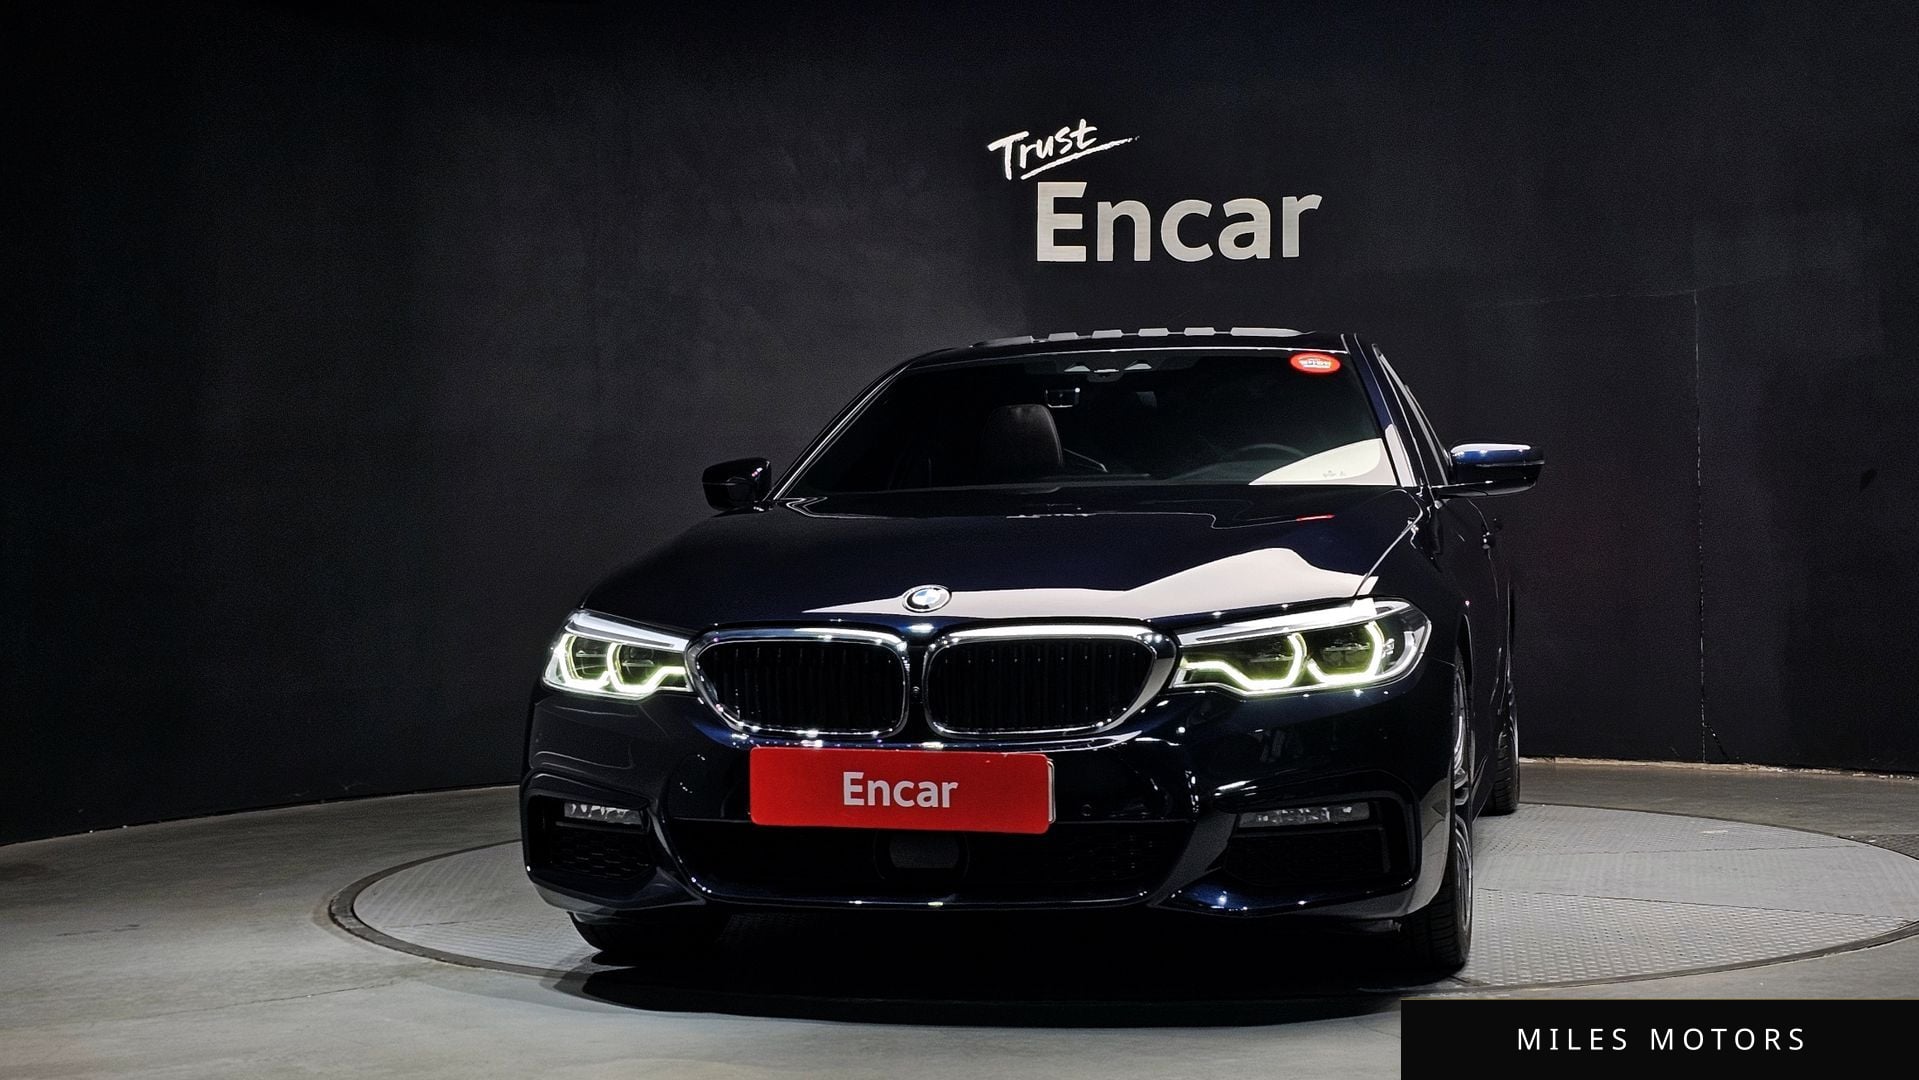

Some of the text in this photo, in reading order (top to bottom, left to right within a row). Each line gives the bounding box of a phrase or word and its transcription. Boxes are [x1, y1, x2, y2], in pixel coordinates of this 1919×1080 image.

[987, 119, 1098, 180] Trust
[1037, 181, 1323, 262] Encar
[842, 771, 958, 808] Encar
